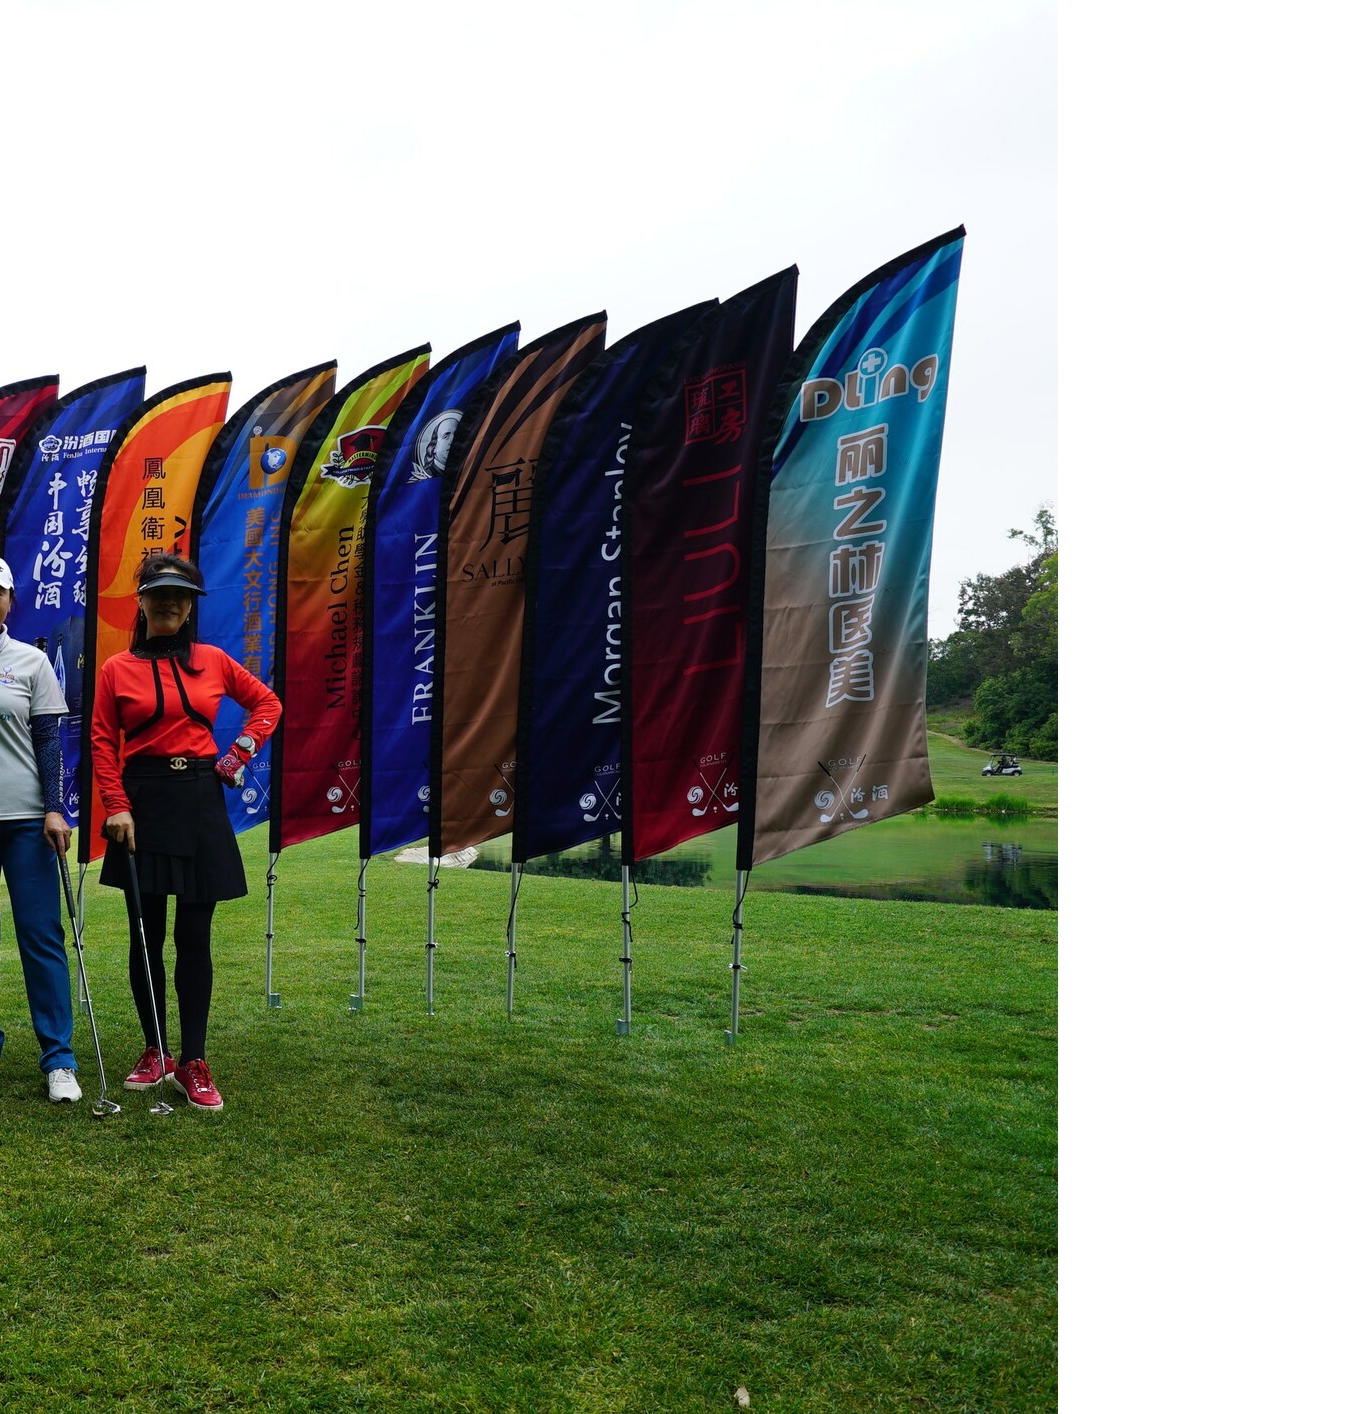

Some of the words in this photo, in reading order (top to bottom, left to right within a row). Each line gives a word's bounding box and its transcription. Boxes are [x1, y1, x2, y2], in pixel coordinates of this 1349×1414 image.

[330, 524, 354, 595] Chen
[682, 464, 742, 676] LIULI
[825, 422, 890, 709] 丽之林医美
[325, 601, 348, 710] Michael
[412, 533, 438, 725] FRANKLIN
[594, 763, 621, 773] GOLF
[700, 752, 727, 764] GOLF
[828, 756, 863, 767] GOLF
